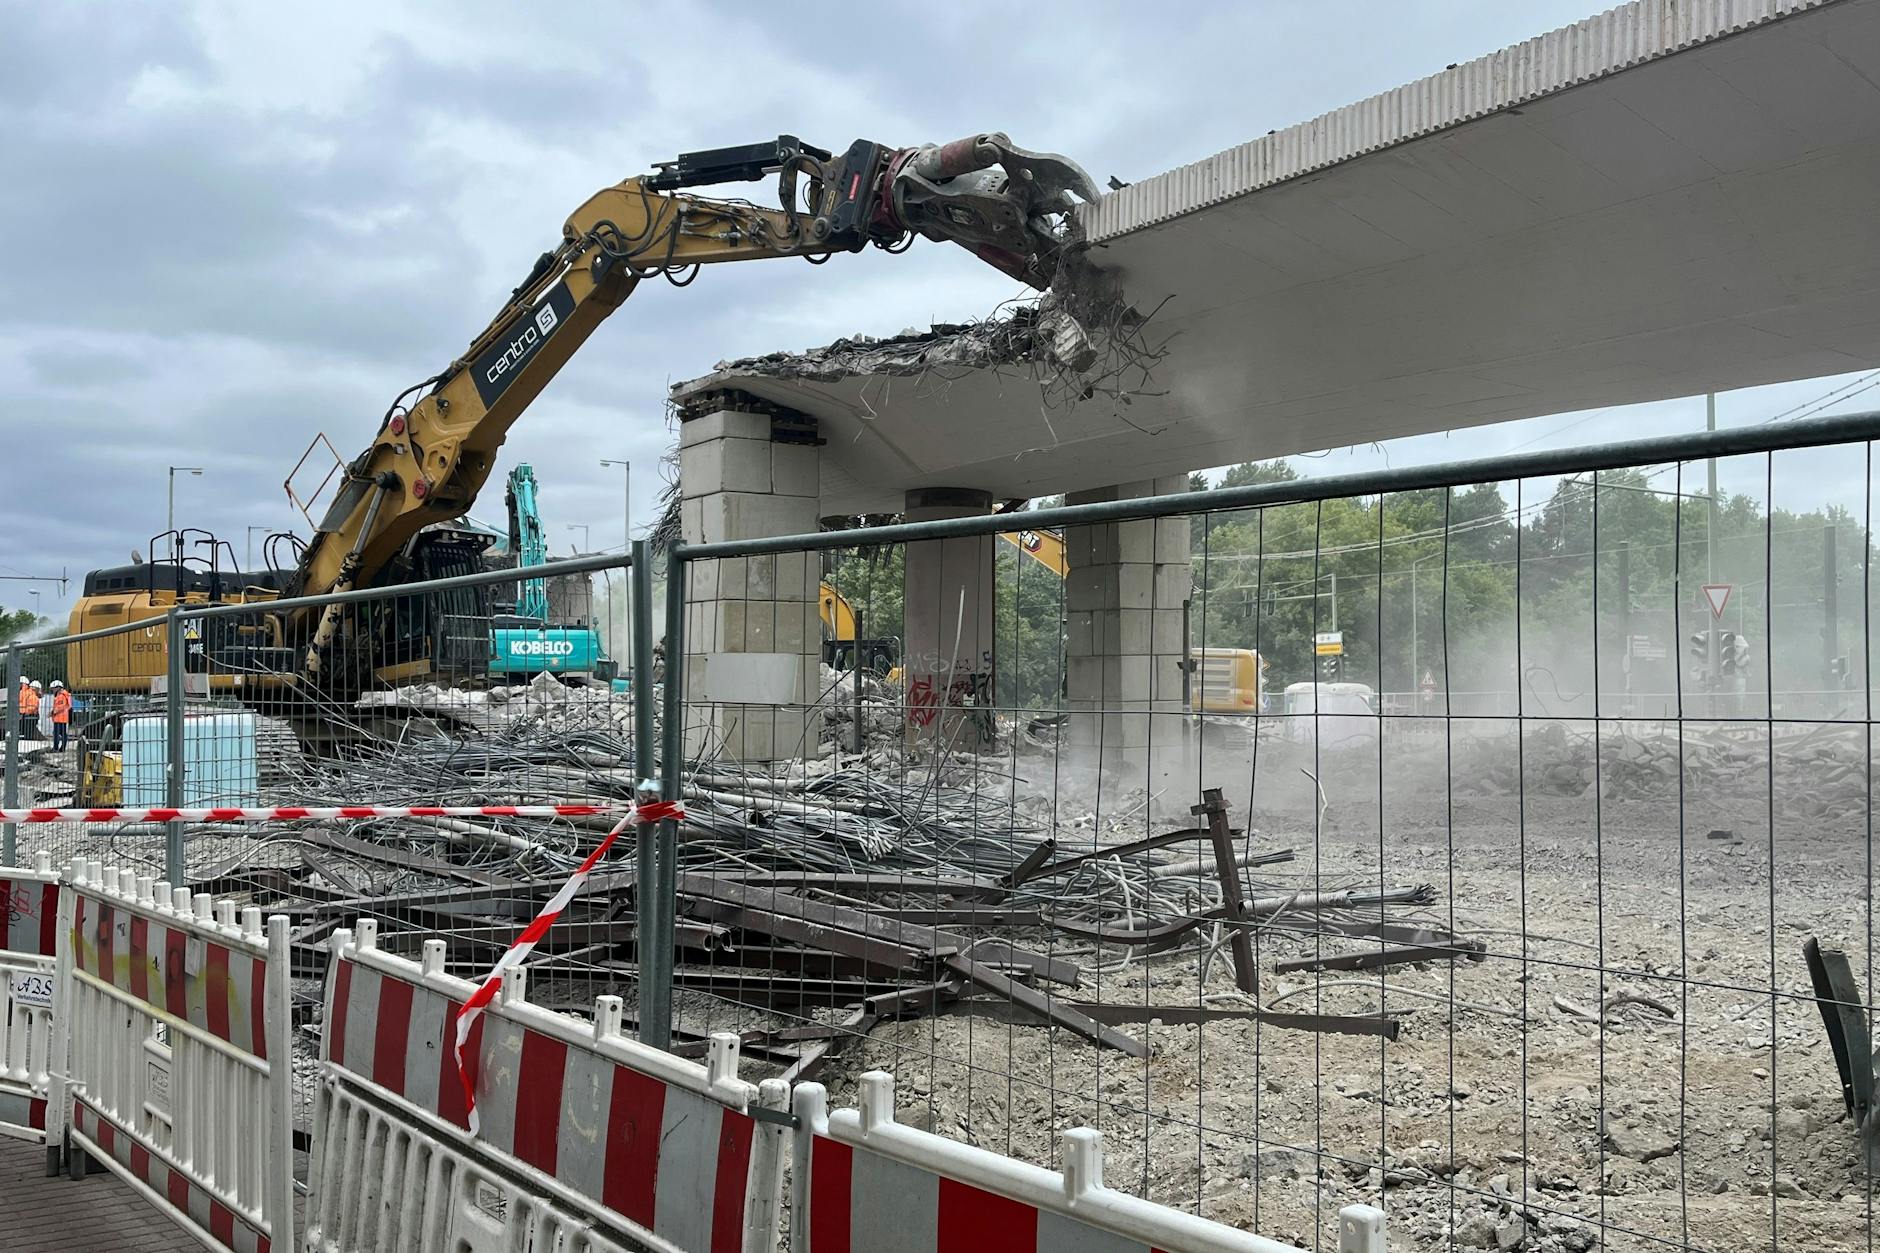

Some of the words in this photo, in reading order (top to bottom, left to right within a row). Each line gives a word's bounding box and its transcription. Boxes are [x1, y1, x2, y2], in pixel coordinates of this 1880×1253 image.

[486, 325, 537, 384] centro
[511, 640, 574, 656] KOBELCO
[17, 976, 53, 996] ABS
